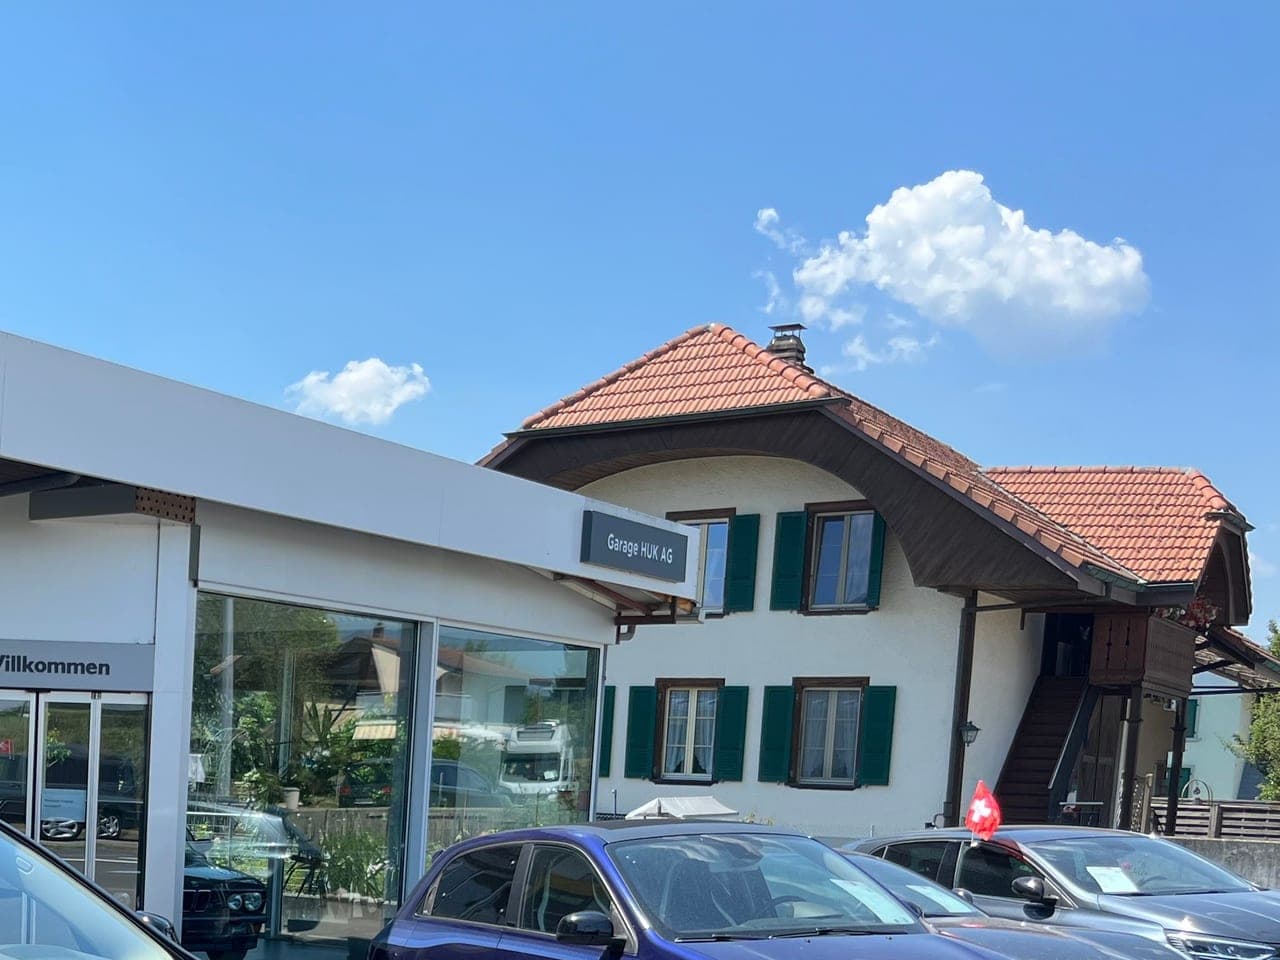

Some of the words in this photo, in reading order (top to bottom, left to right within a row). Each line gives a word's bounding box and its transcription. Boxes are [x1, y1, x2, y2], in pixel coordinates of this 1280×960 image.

[607, 533, 638, 558] Garage
[640, 541, 658, 560] HUK
[660, 546, 673, 564] AG
